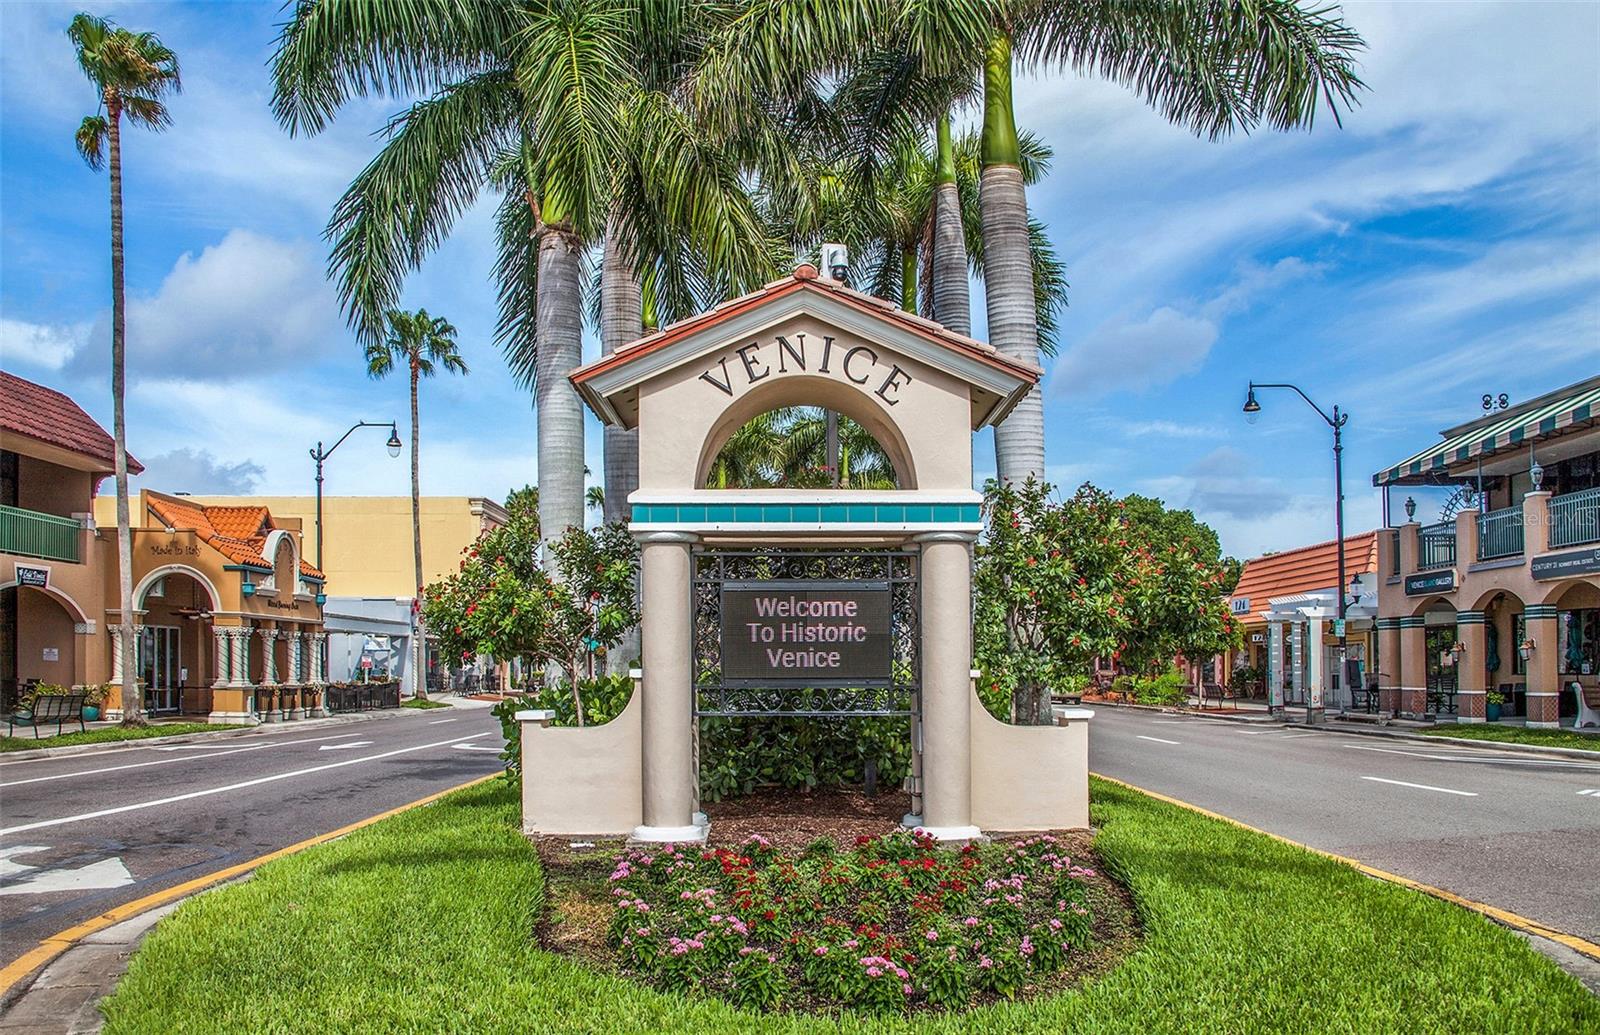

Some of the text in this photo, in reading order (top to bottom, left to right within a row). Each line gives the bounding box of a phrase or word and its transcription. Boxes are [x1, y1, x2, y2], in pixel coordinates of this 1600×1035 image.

[698, 334, 912, 406] VENICE
[754, 596, 857, 617] Welcome
[746, 621, 867, 643] To Historic
[766, 647, 840, 667] Venice
